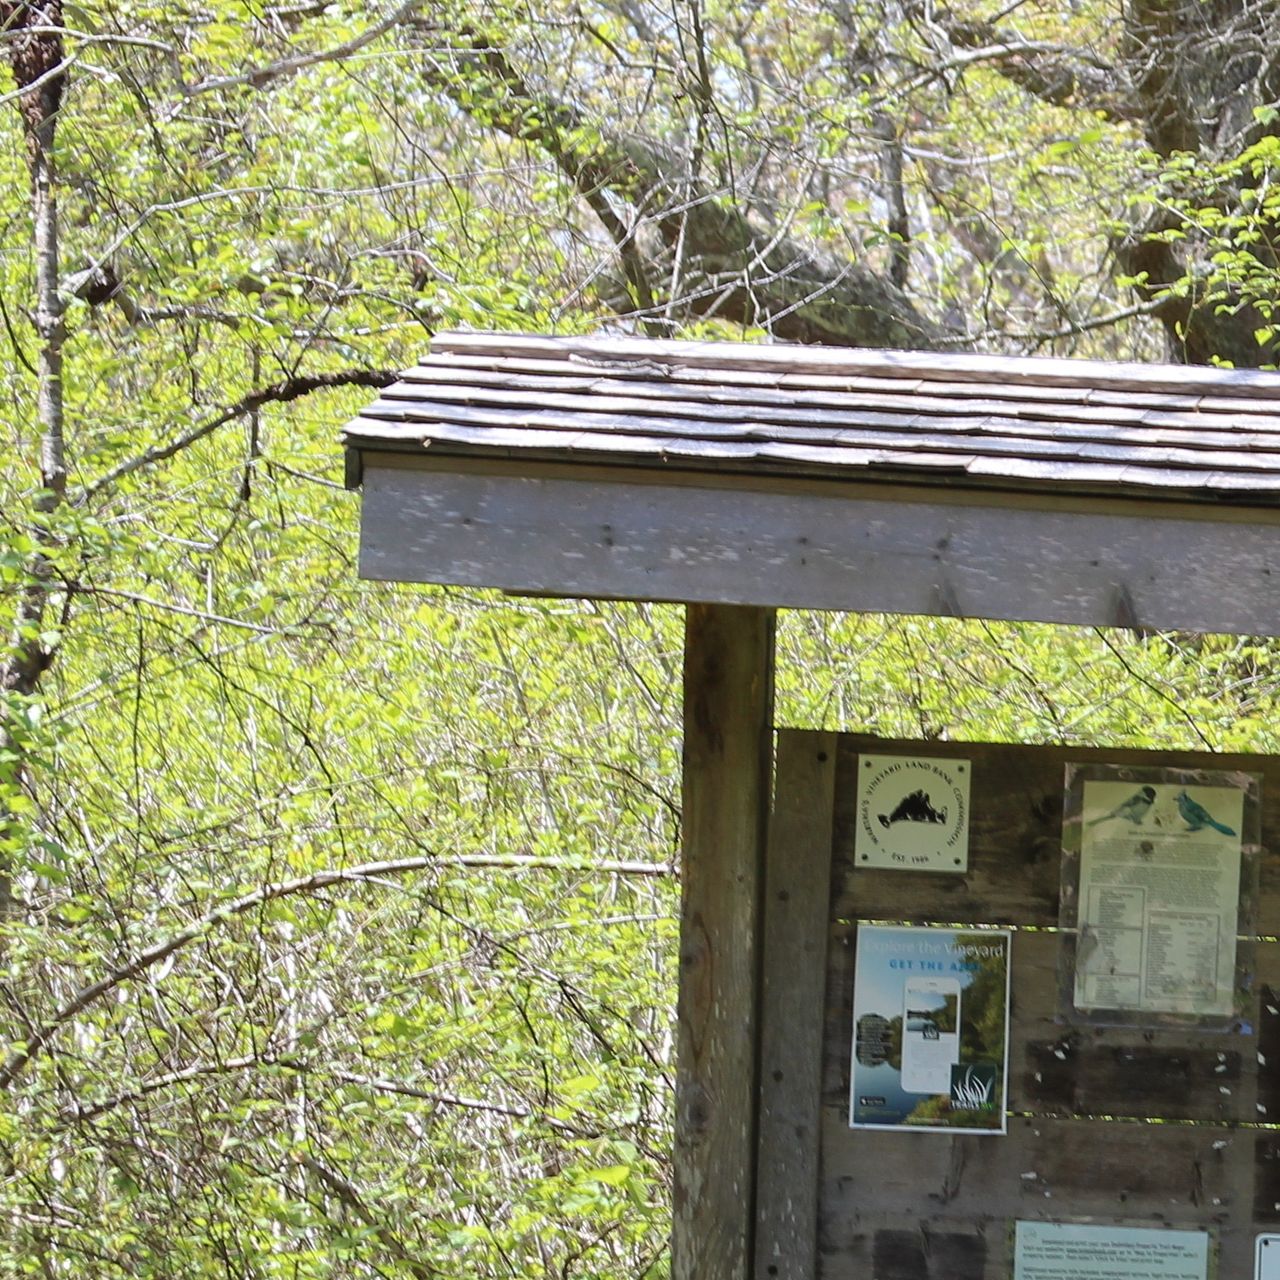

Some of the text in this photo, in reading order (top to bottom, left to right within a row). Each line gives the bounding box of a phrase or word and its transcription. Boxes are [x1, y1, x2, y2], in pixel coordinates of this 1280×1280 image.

[905, 761, 931, 770] LAND
[932, 766, 953, 785] BANK
[918, 940, 942, 955] the
[945, 941, 1003, 959] Vineyard
[890, 959, 912, 970] GET
[920, 960, 944, 970] THE
